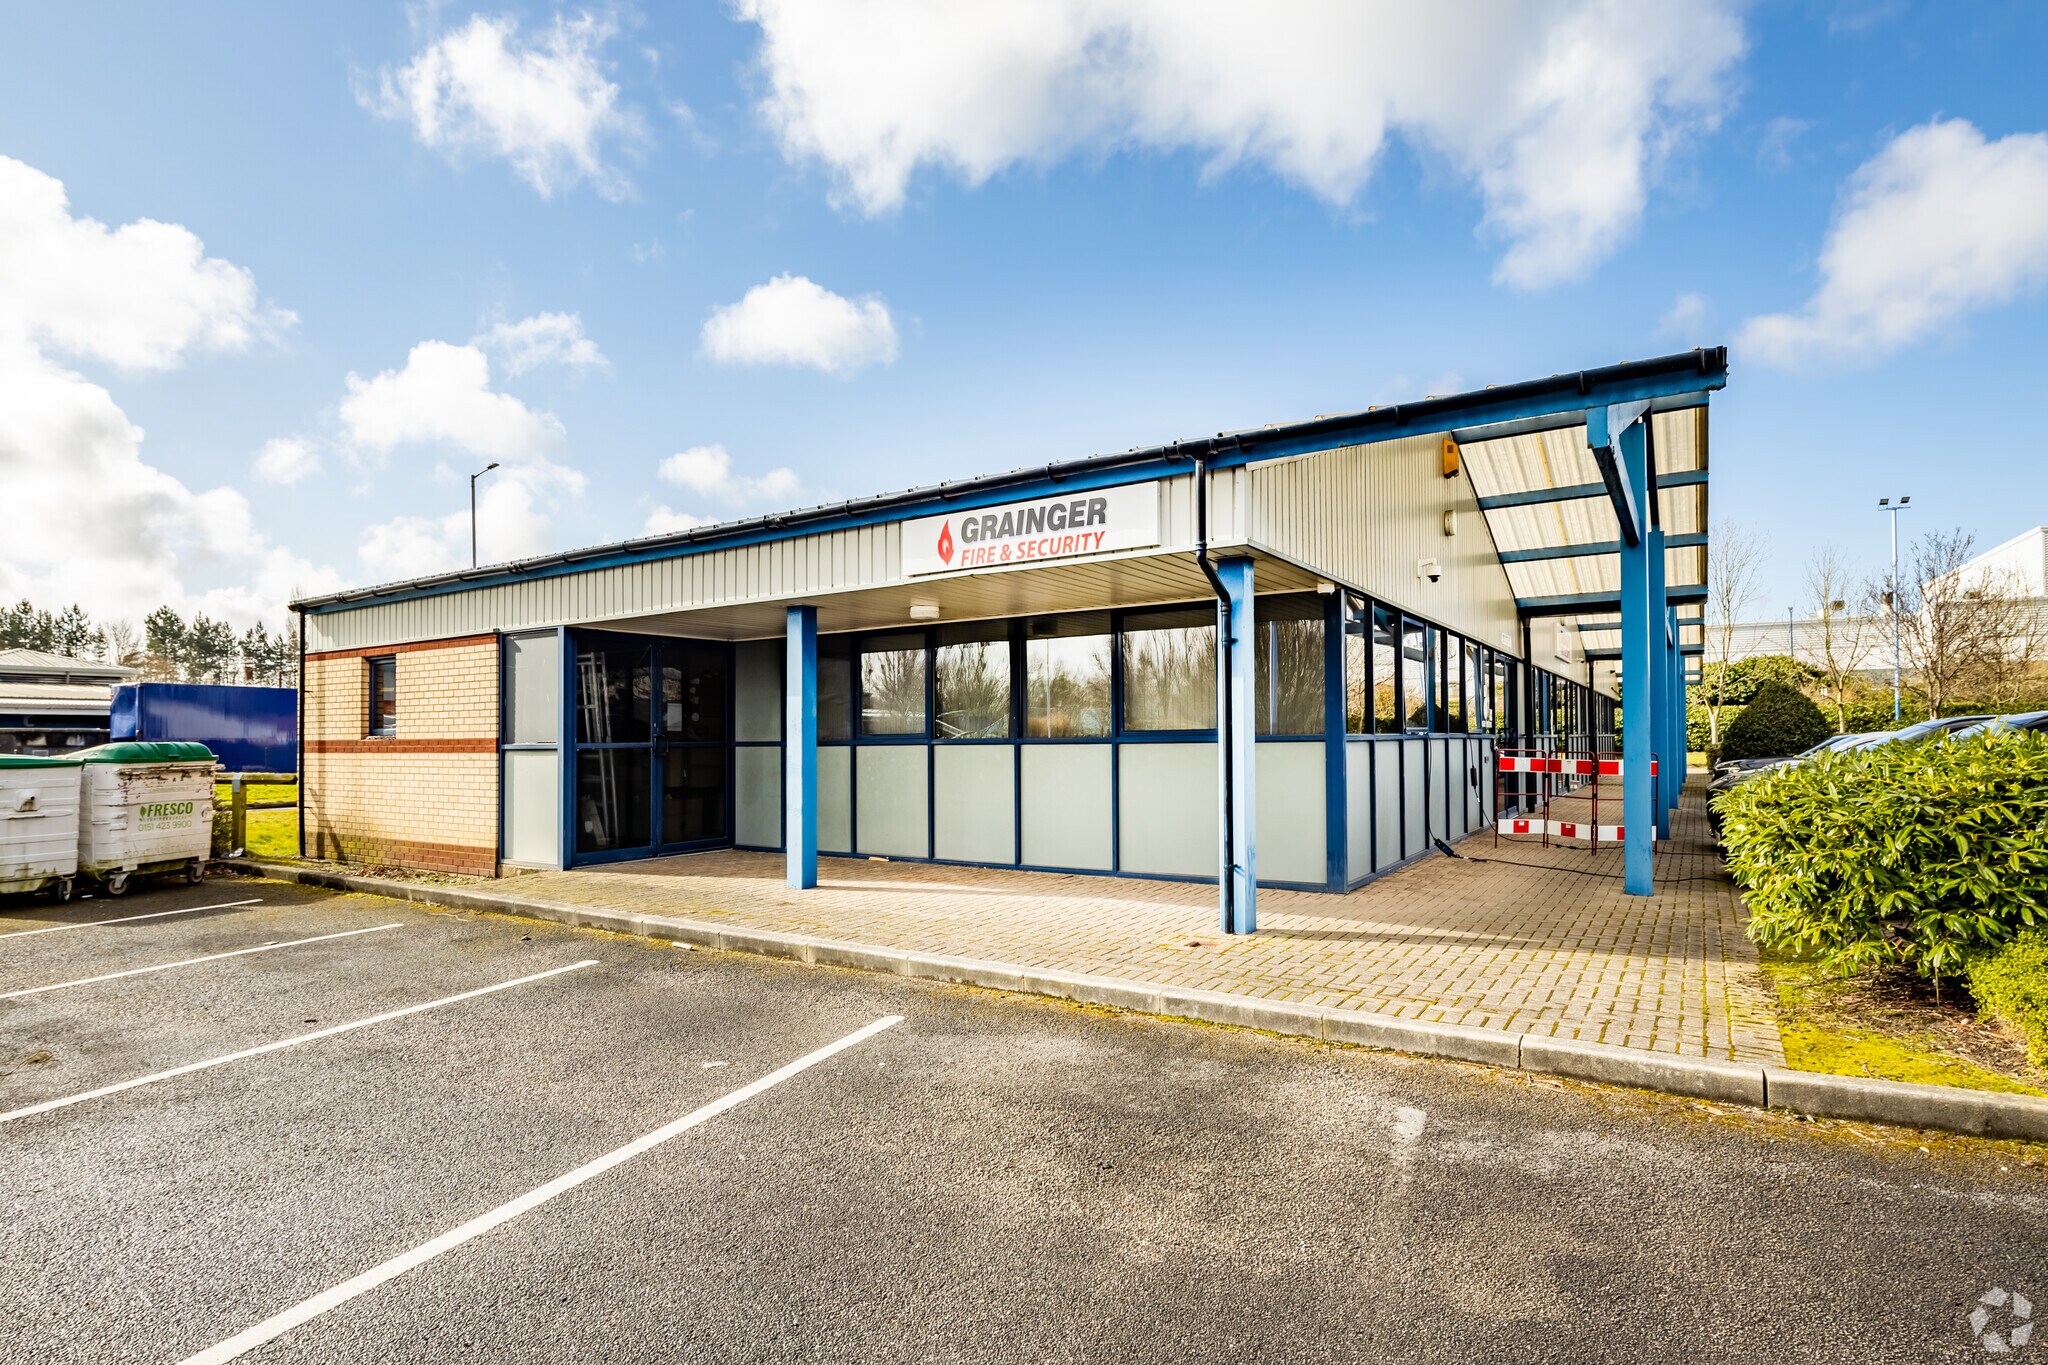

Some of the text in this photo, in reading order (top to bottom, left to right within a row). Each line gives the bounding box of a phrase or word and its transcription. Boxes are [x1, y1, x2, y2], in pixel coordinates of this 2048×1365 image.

[961, 497, 1106, 543] GRAINGER
[961, 531, 1105, 566] FIRE & SECURITY
[147, 802, 193, 816] FRESCO
[138, 823, 154, 831] 0151
[172, 820, 192, 829] 9900
